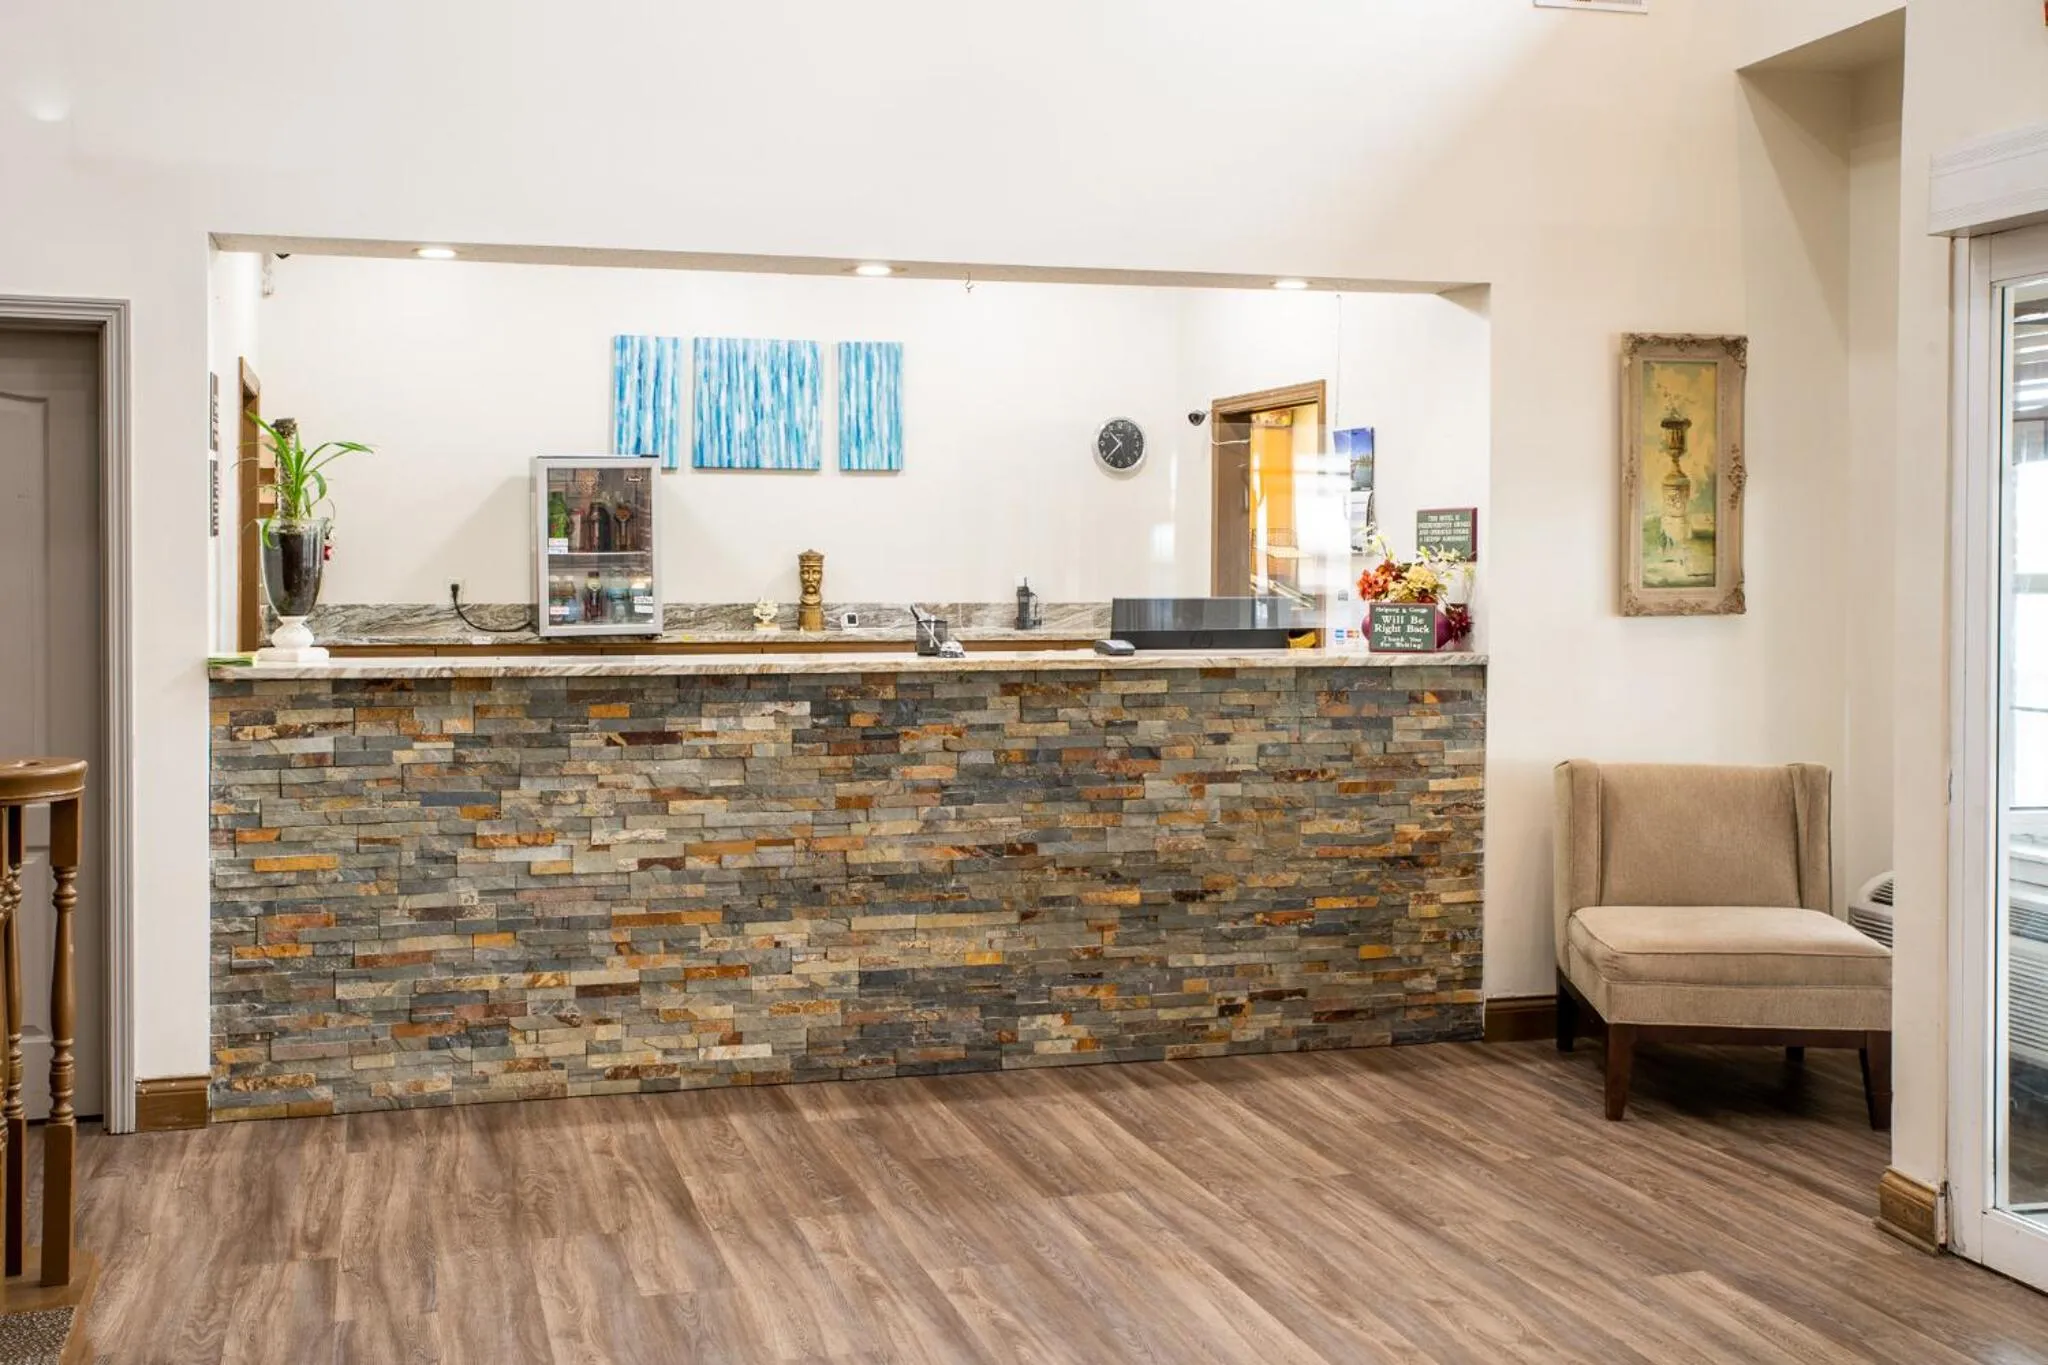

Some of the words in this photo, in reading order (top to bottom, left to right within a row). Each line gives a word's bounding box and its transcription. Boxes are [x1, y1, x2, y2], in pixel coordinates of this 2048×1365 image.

[1381, 615, 1404, 624] Will
[1410, 615, 1425, 624] Be
[1374, 623, 1401, 635] Right
[1407, 624, 1430, 633] Back
